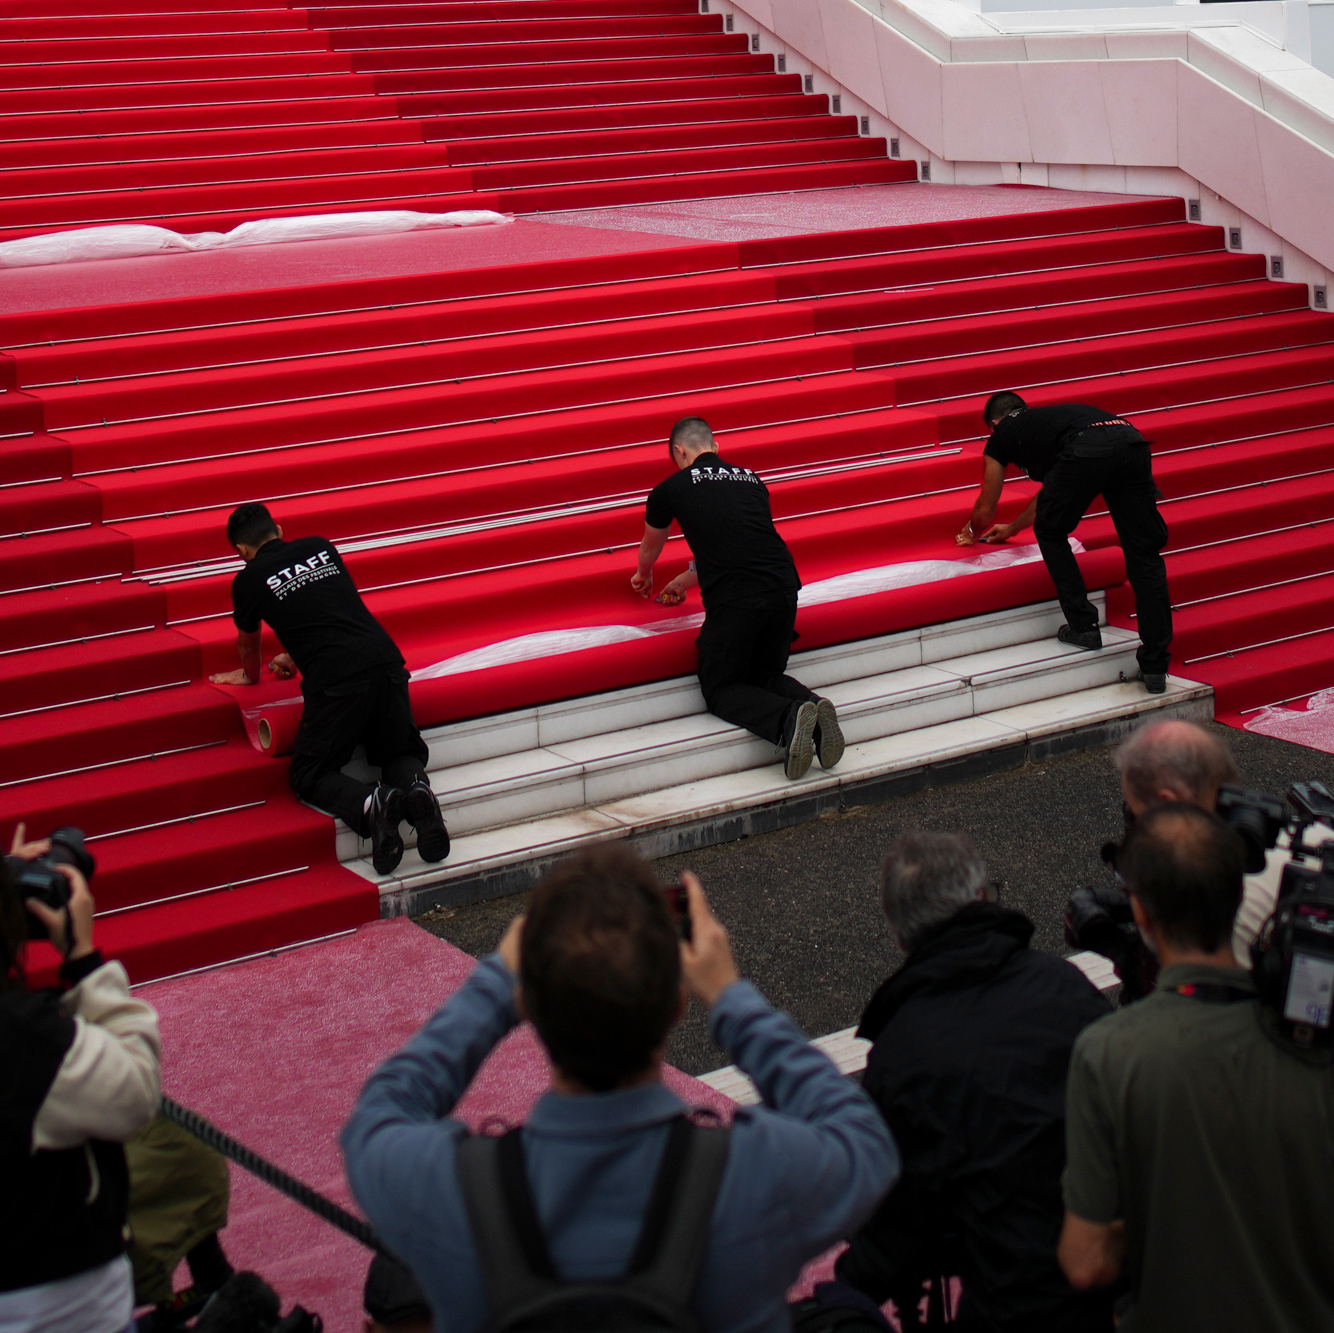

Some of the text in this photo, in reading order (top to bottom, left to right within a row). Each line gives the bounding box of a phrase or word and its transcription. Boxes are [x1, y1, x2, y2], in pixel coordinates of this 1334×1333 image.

[691, 467, 753, 476] STAFF
[266, 550, 331, 590] STAFF
[275, 565, 338, 597] PALAIS DES FESTIVALS
[291, 581, 306, 592] DES
